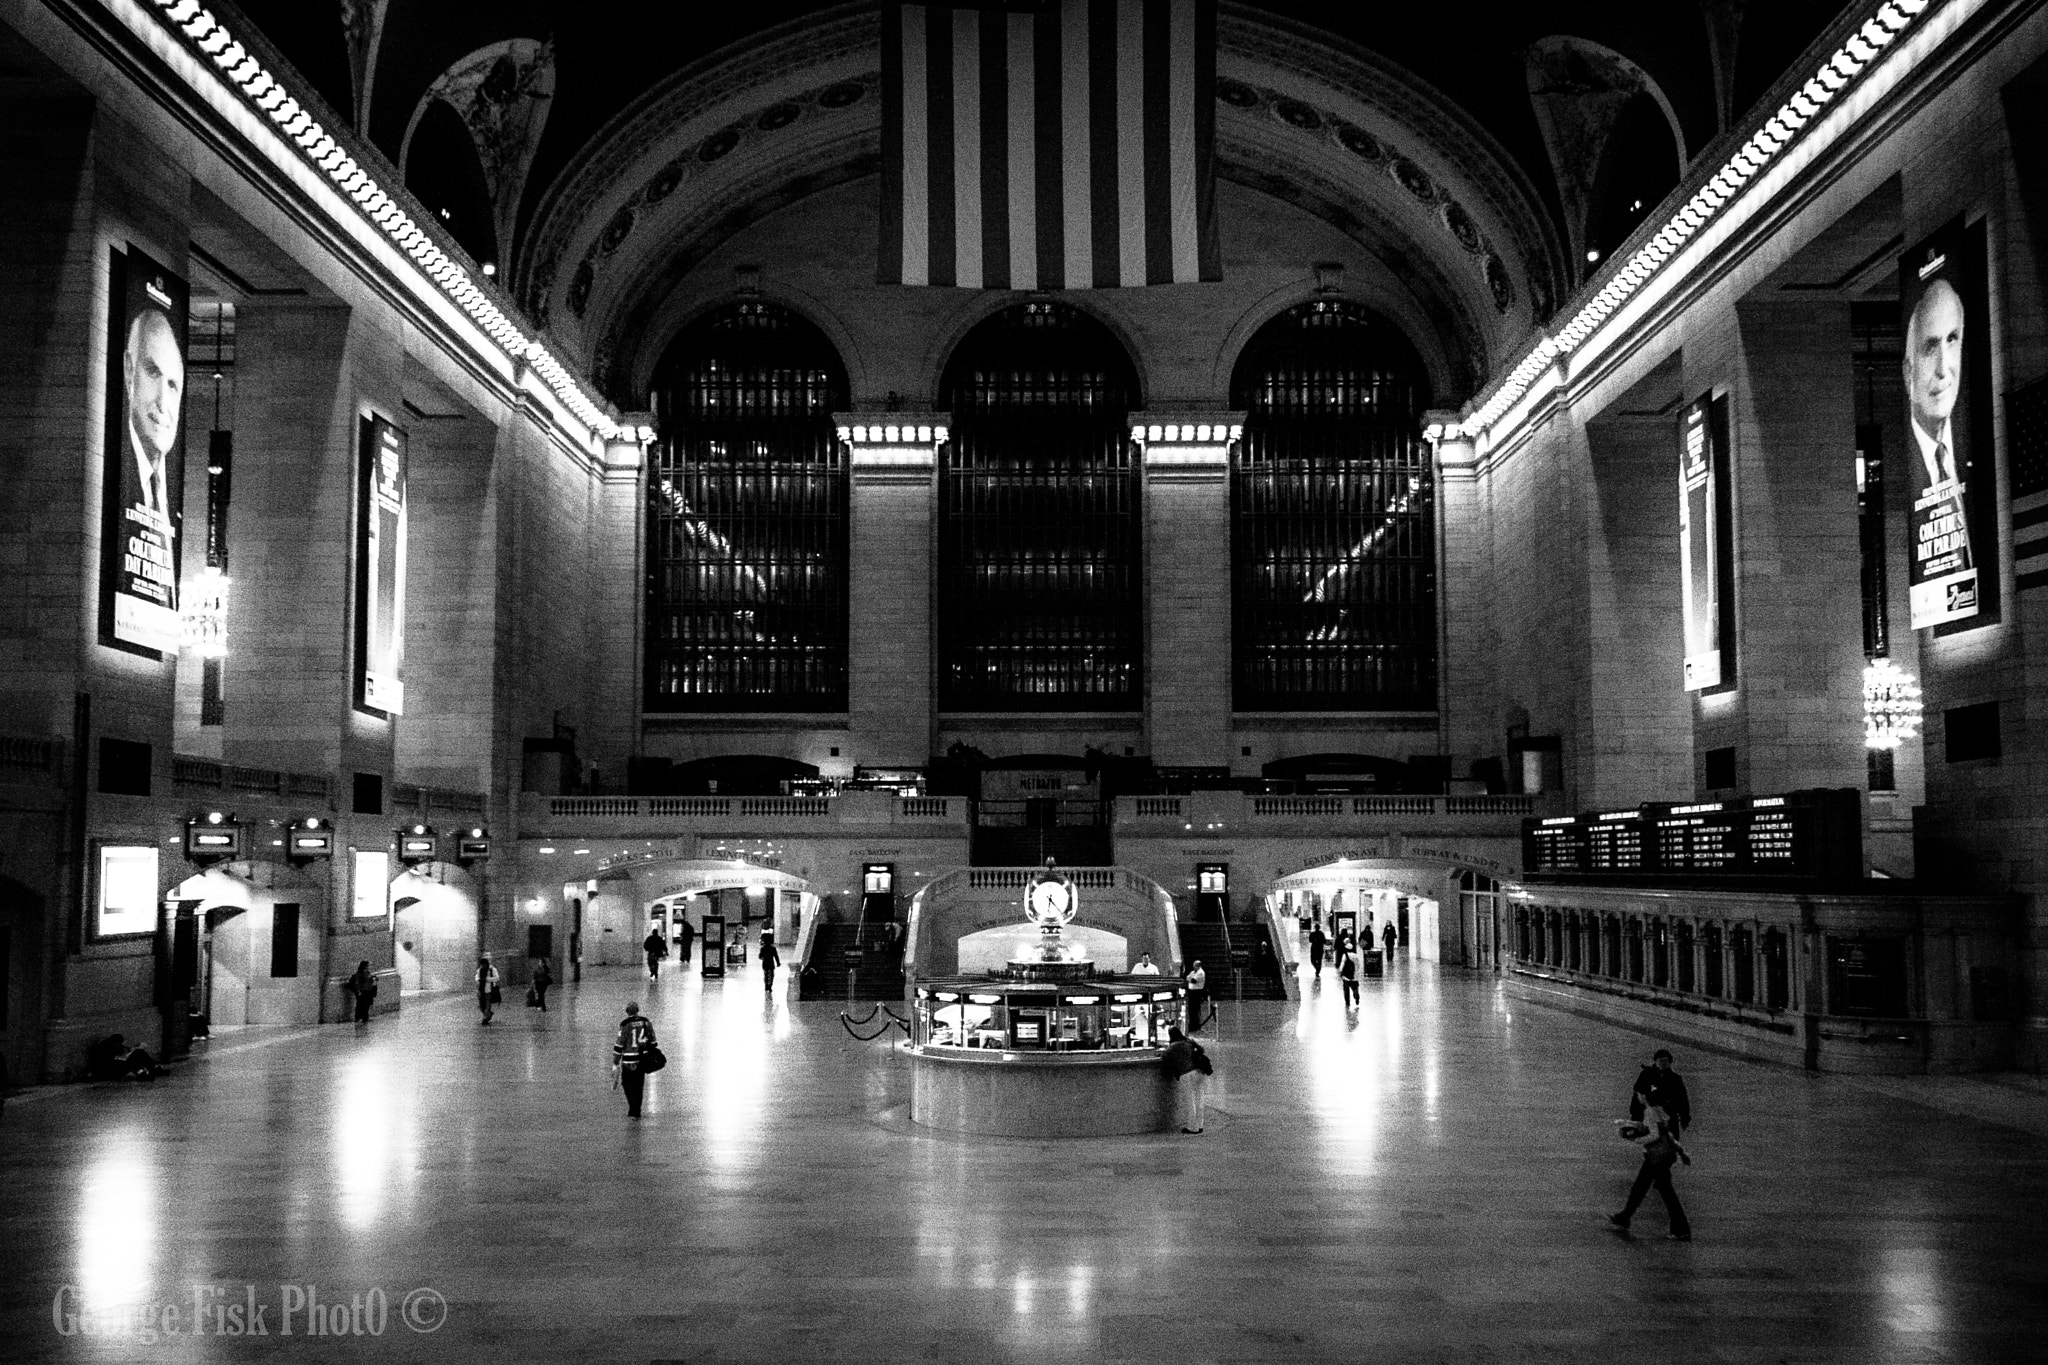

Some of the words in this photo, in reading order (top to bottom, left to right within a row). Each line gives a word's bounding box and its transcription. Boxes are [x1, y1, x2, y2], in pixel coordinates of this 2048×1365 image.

[1917, 541, 1933, 562] DAY
[1934, 528, 1967, 557] PARADE
[706, 849, 761, 863] LEXINGTON
[763, 857, 781, 867] AVE
[1303, 849, 1359, 867] LEXINGTON
[1360, 847, 1379, 857] AVE
[1412, 847, 1450, 860] SUBWAY
[713, 878, 745, 886] PASSAGE
[1279, 878, 1309, 889] STREET
